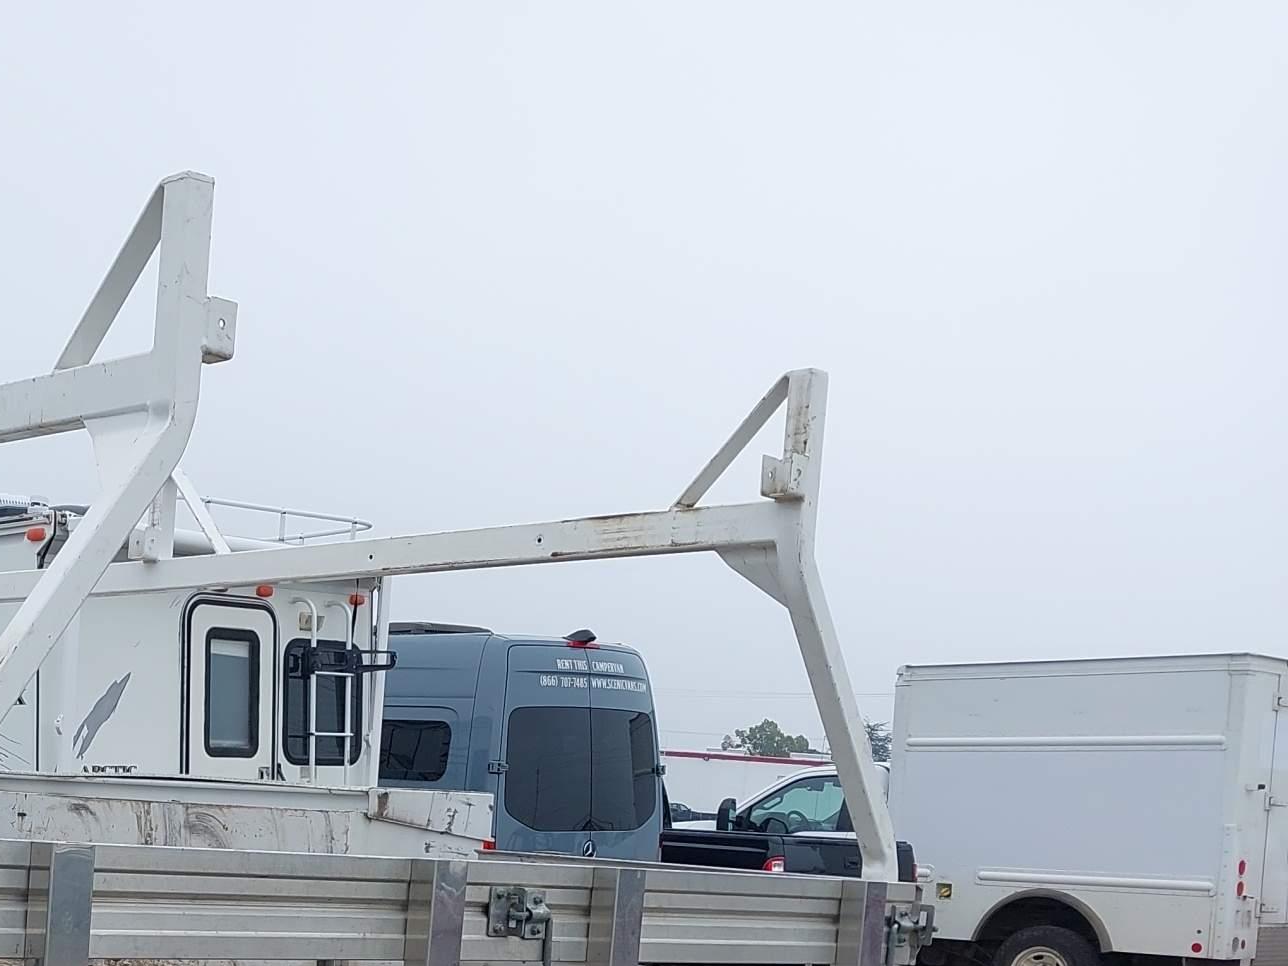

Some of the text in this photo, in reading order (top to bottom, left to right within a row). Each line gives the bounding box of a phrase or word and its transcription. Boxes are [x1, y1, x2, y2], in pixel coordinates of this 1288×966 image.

[556, 658, 573, 670] RENT
[574, 660, 588, 671] THIS
[540, 674, 559, 688] (866)
